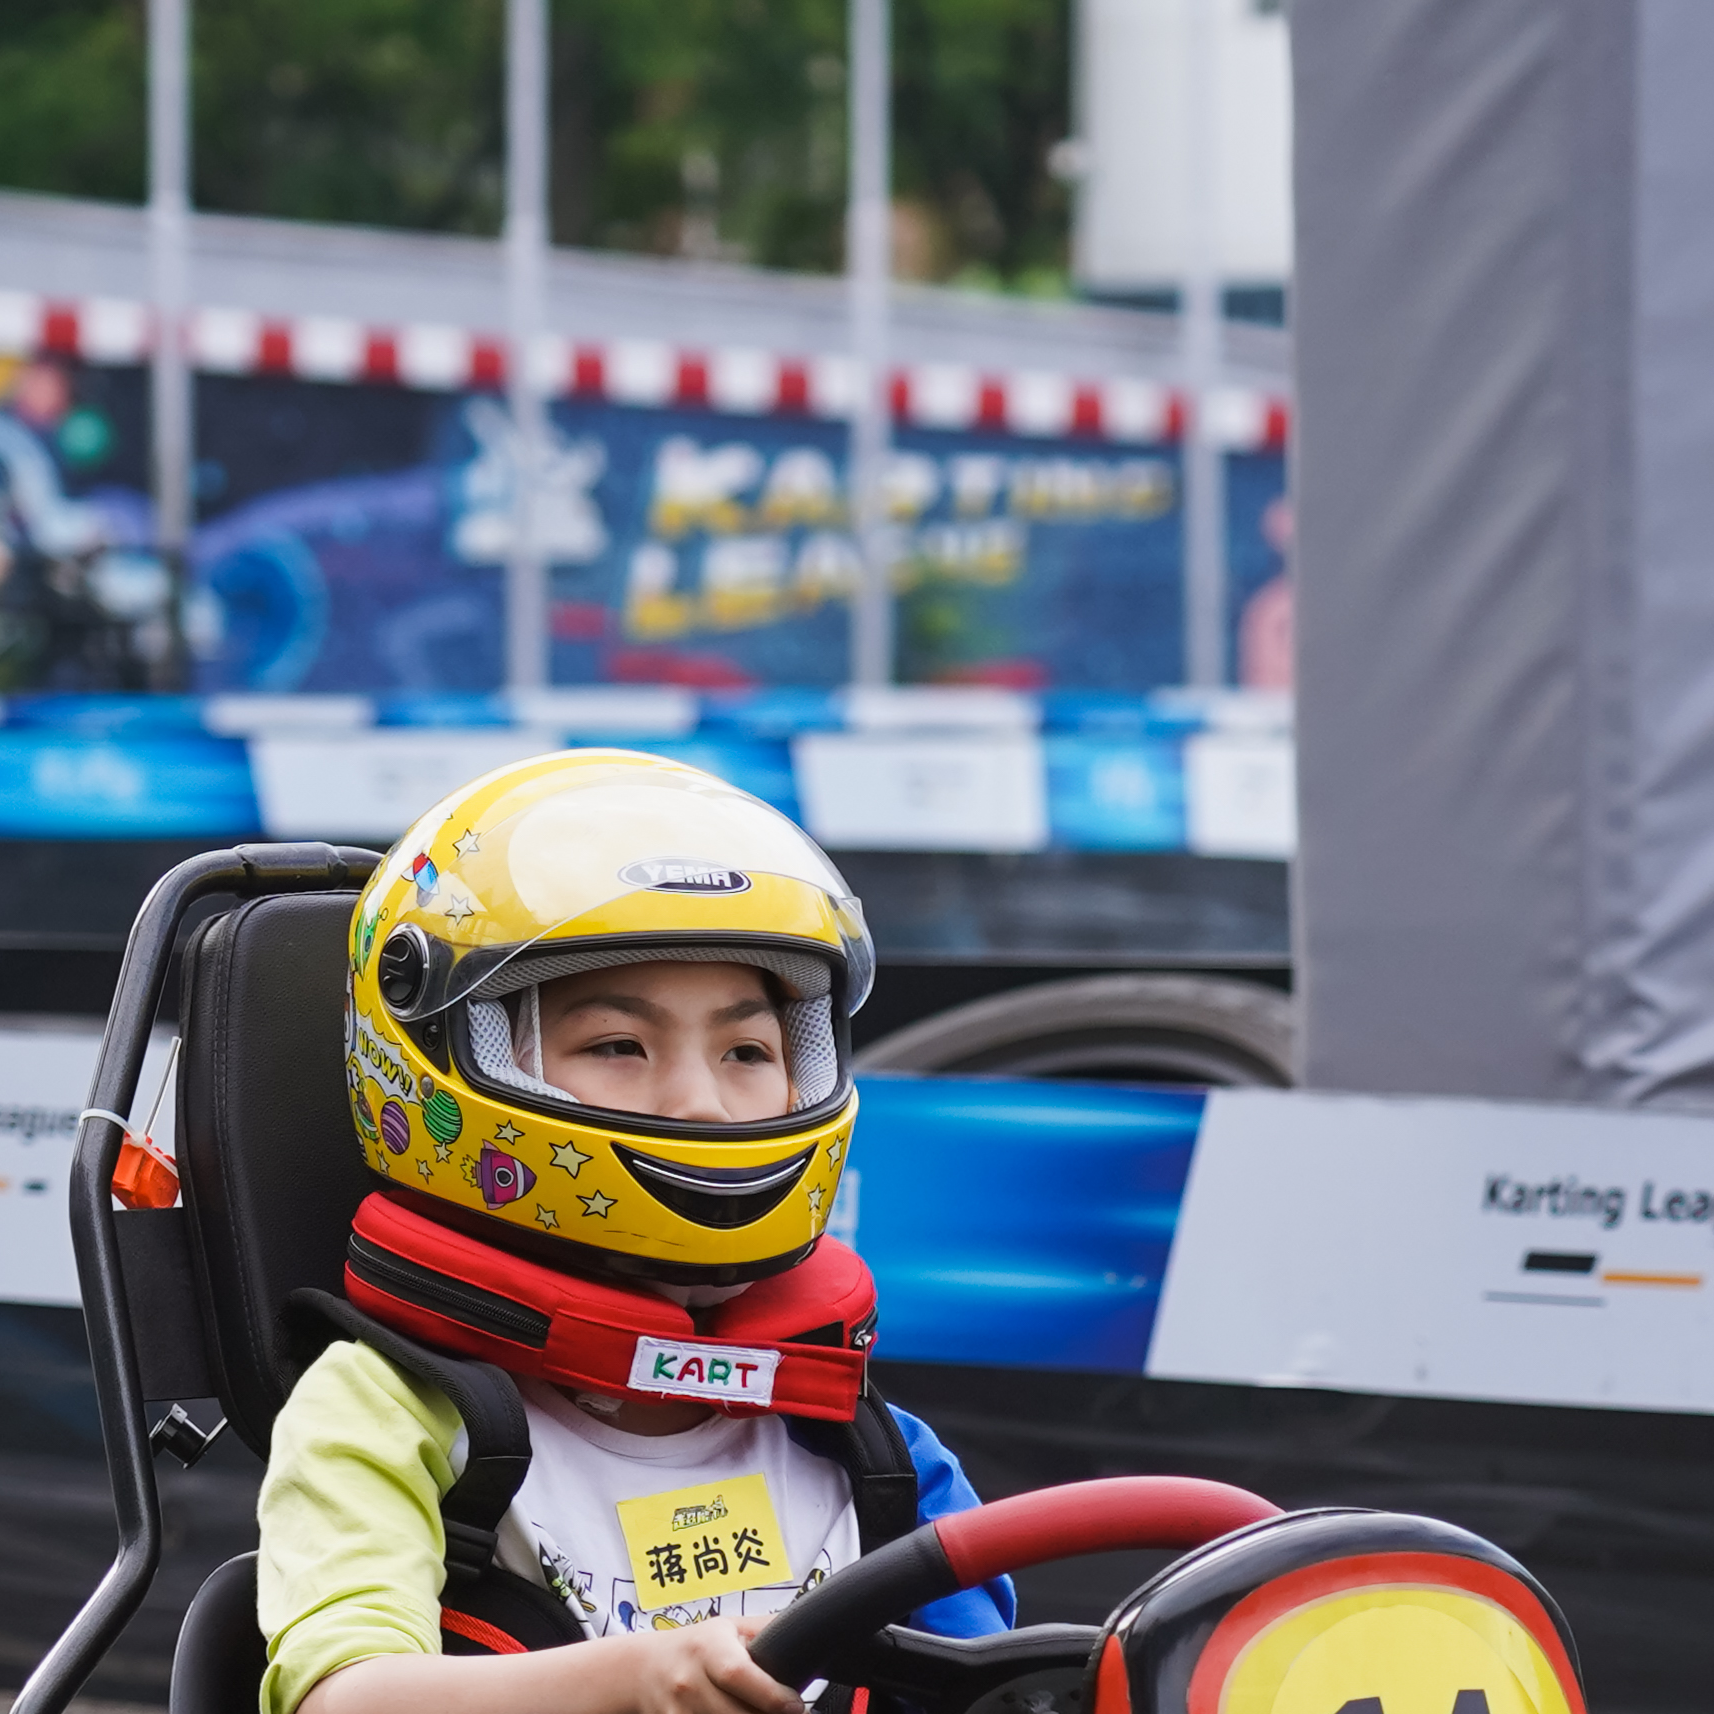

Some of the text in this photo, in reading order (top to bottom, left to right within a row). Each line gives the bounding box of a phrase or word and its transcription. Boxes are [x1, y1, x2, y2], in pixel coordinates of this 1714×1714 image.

[641, 864, 732, 888] YEMA
[1483, 1175, 1628, 1231] Karting
[652, 1351, 759, 1389] KART
[646, 1527, 770, 1588] 蒋尚炎
